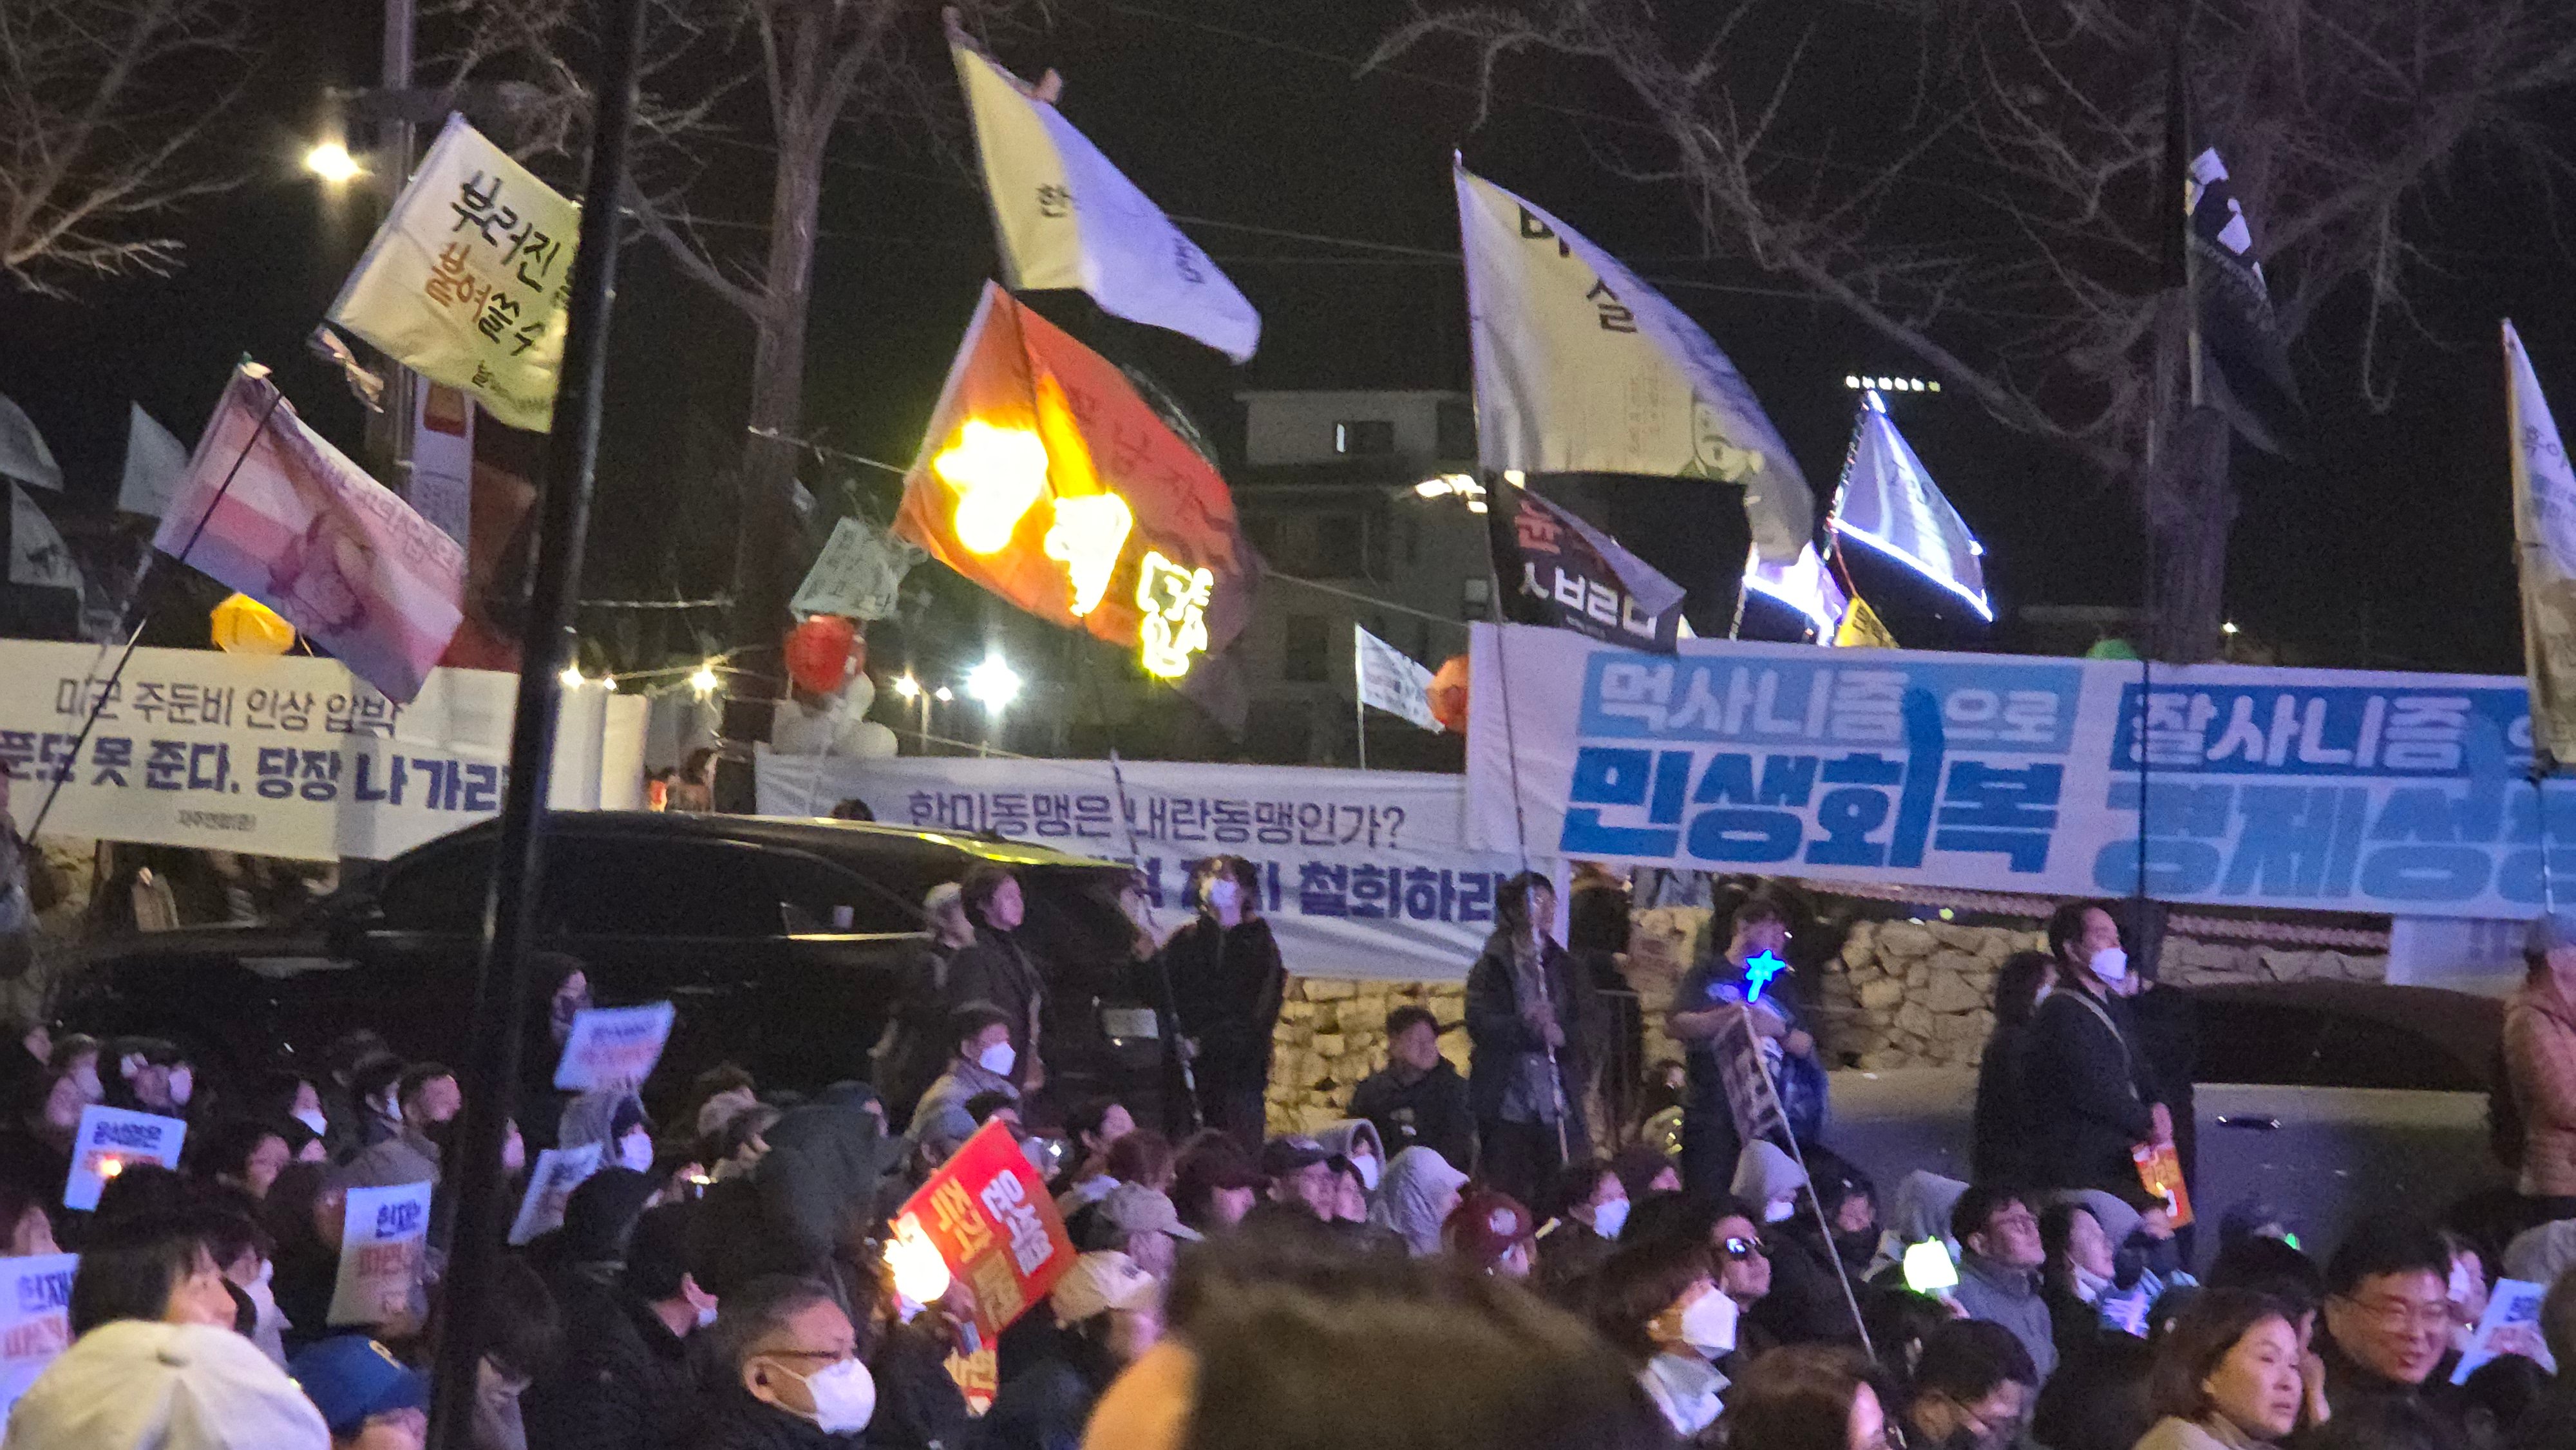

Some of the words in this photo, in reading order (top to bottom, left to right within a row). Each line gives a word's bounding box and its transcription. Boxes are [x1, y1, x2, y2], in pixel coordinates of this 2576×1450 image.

[450, 169, 562, 293] 부러진
[132, 681, 235, 728] 주둔비
[245, 689, 316, 733] 인상
[2129, 691, 2473, 772] 잘사니즘
[91, 736, 133, 787] 못
[145, 739, 242, 795] 준다.
[256, 746, 341, 802] 당장
[1559, 688, 2066, 874] 민생회복
[908, 789, 1113, 838] 한미동맹은
[1124, 795, 1406, 850] 내란동맹인가?
